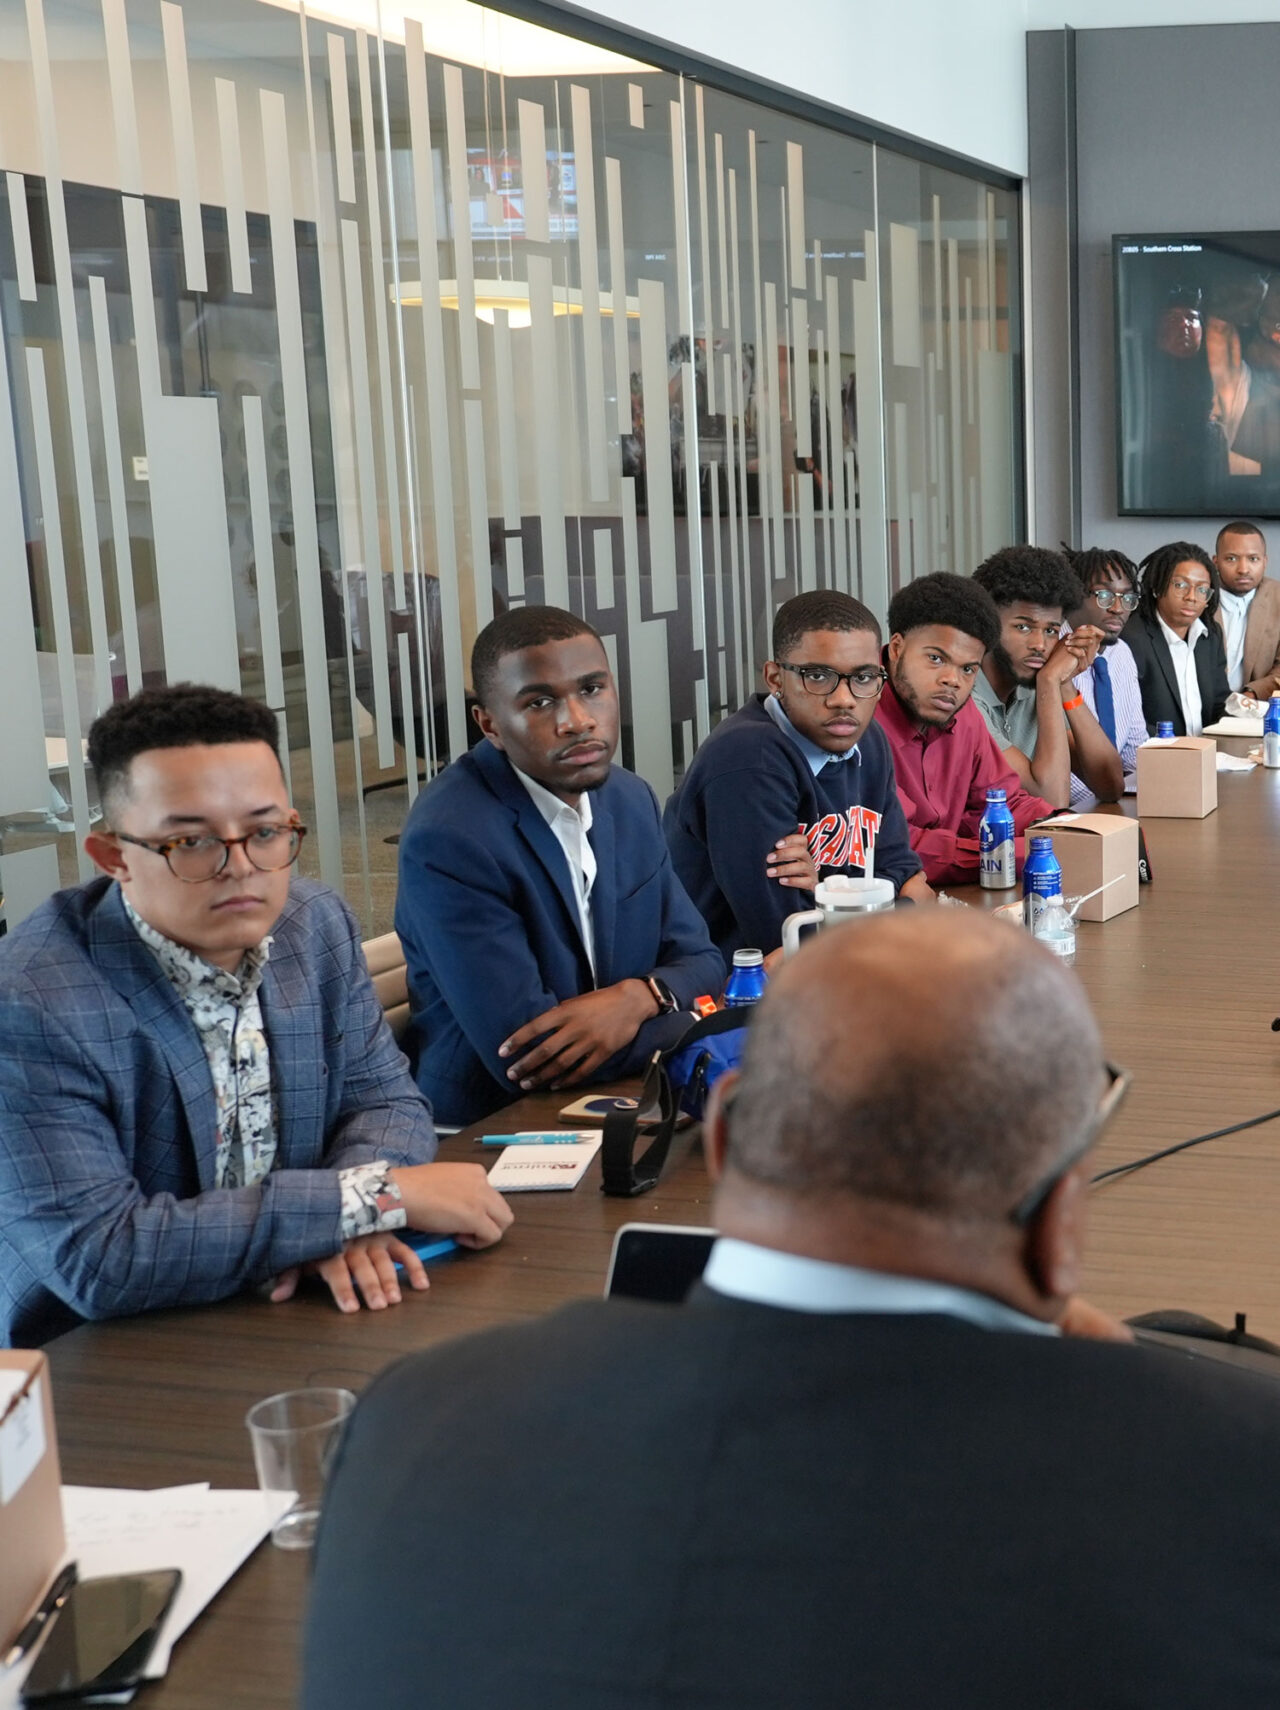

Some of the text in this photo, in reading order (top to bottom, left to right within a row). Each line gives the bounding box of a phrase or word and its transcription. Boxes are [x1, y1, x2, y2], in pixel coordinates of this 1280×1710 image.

[1143, 245, 1167, 253] Southern
[1182, 244, 1202, 252] Station
[980, 860, 1002, 872] AIN
